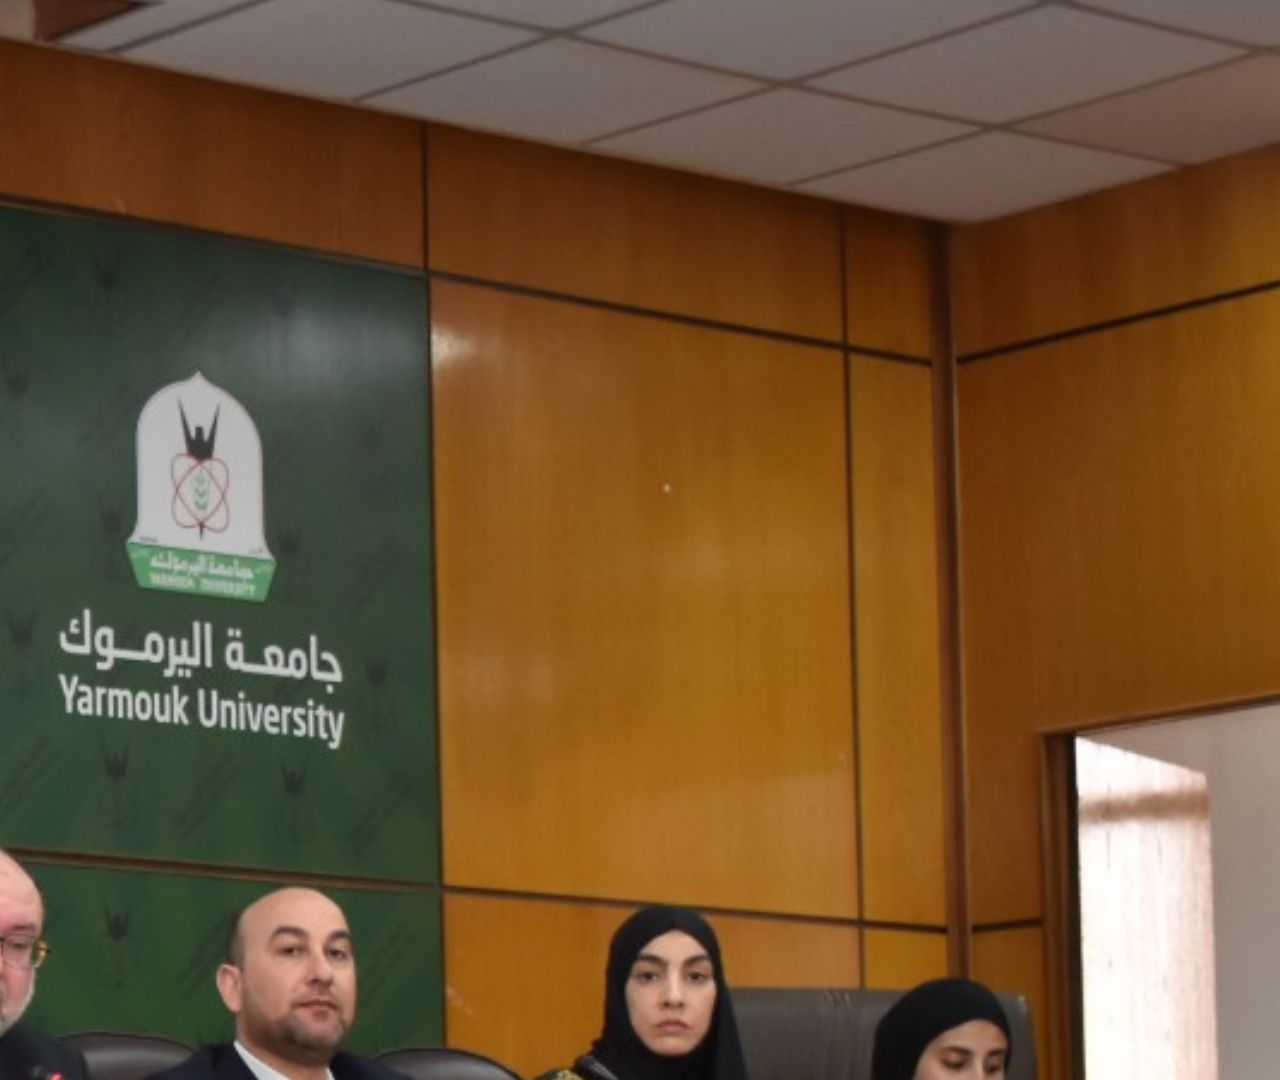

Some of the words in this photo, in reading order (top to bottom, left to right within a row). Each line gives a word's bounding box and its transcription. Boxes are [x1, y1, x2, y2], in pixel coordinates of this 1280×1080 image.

[58, 607, 213, 678] اليرموك
[224, 626, 344, 694] جامعة
[58, 672, 190, 725] Yarmouk
[197, 687, 345, 750] University
